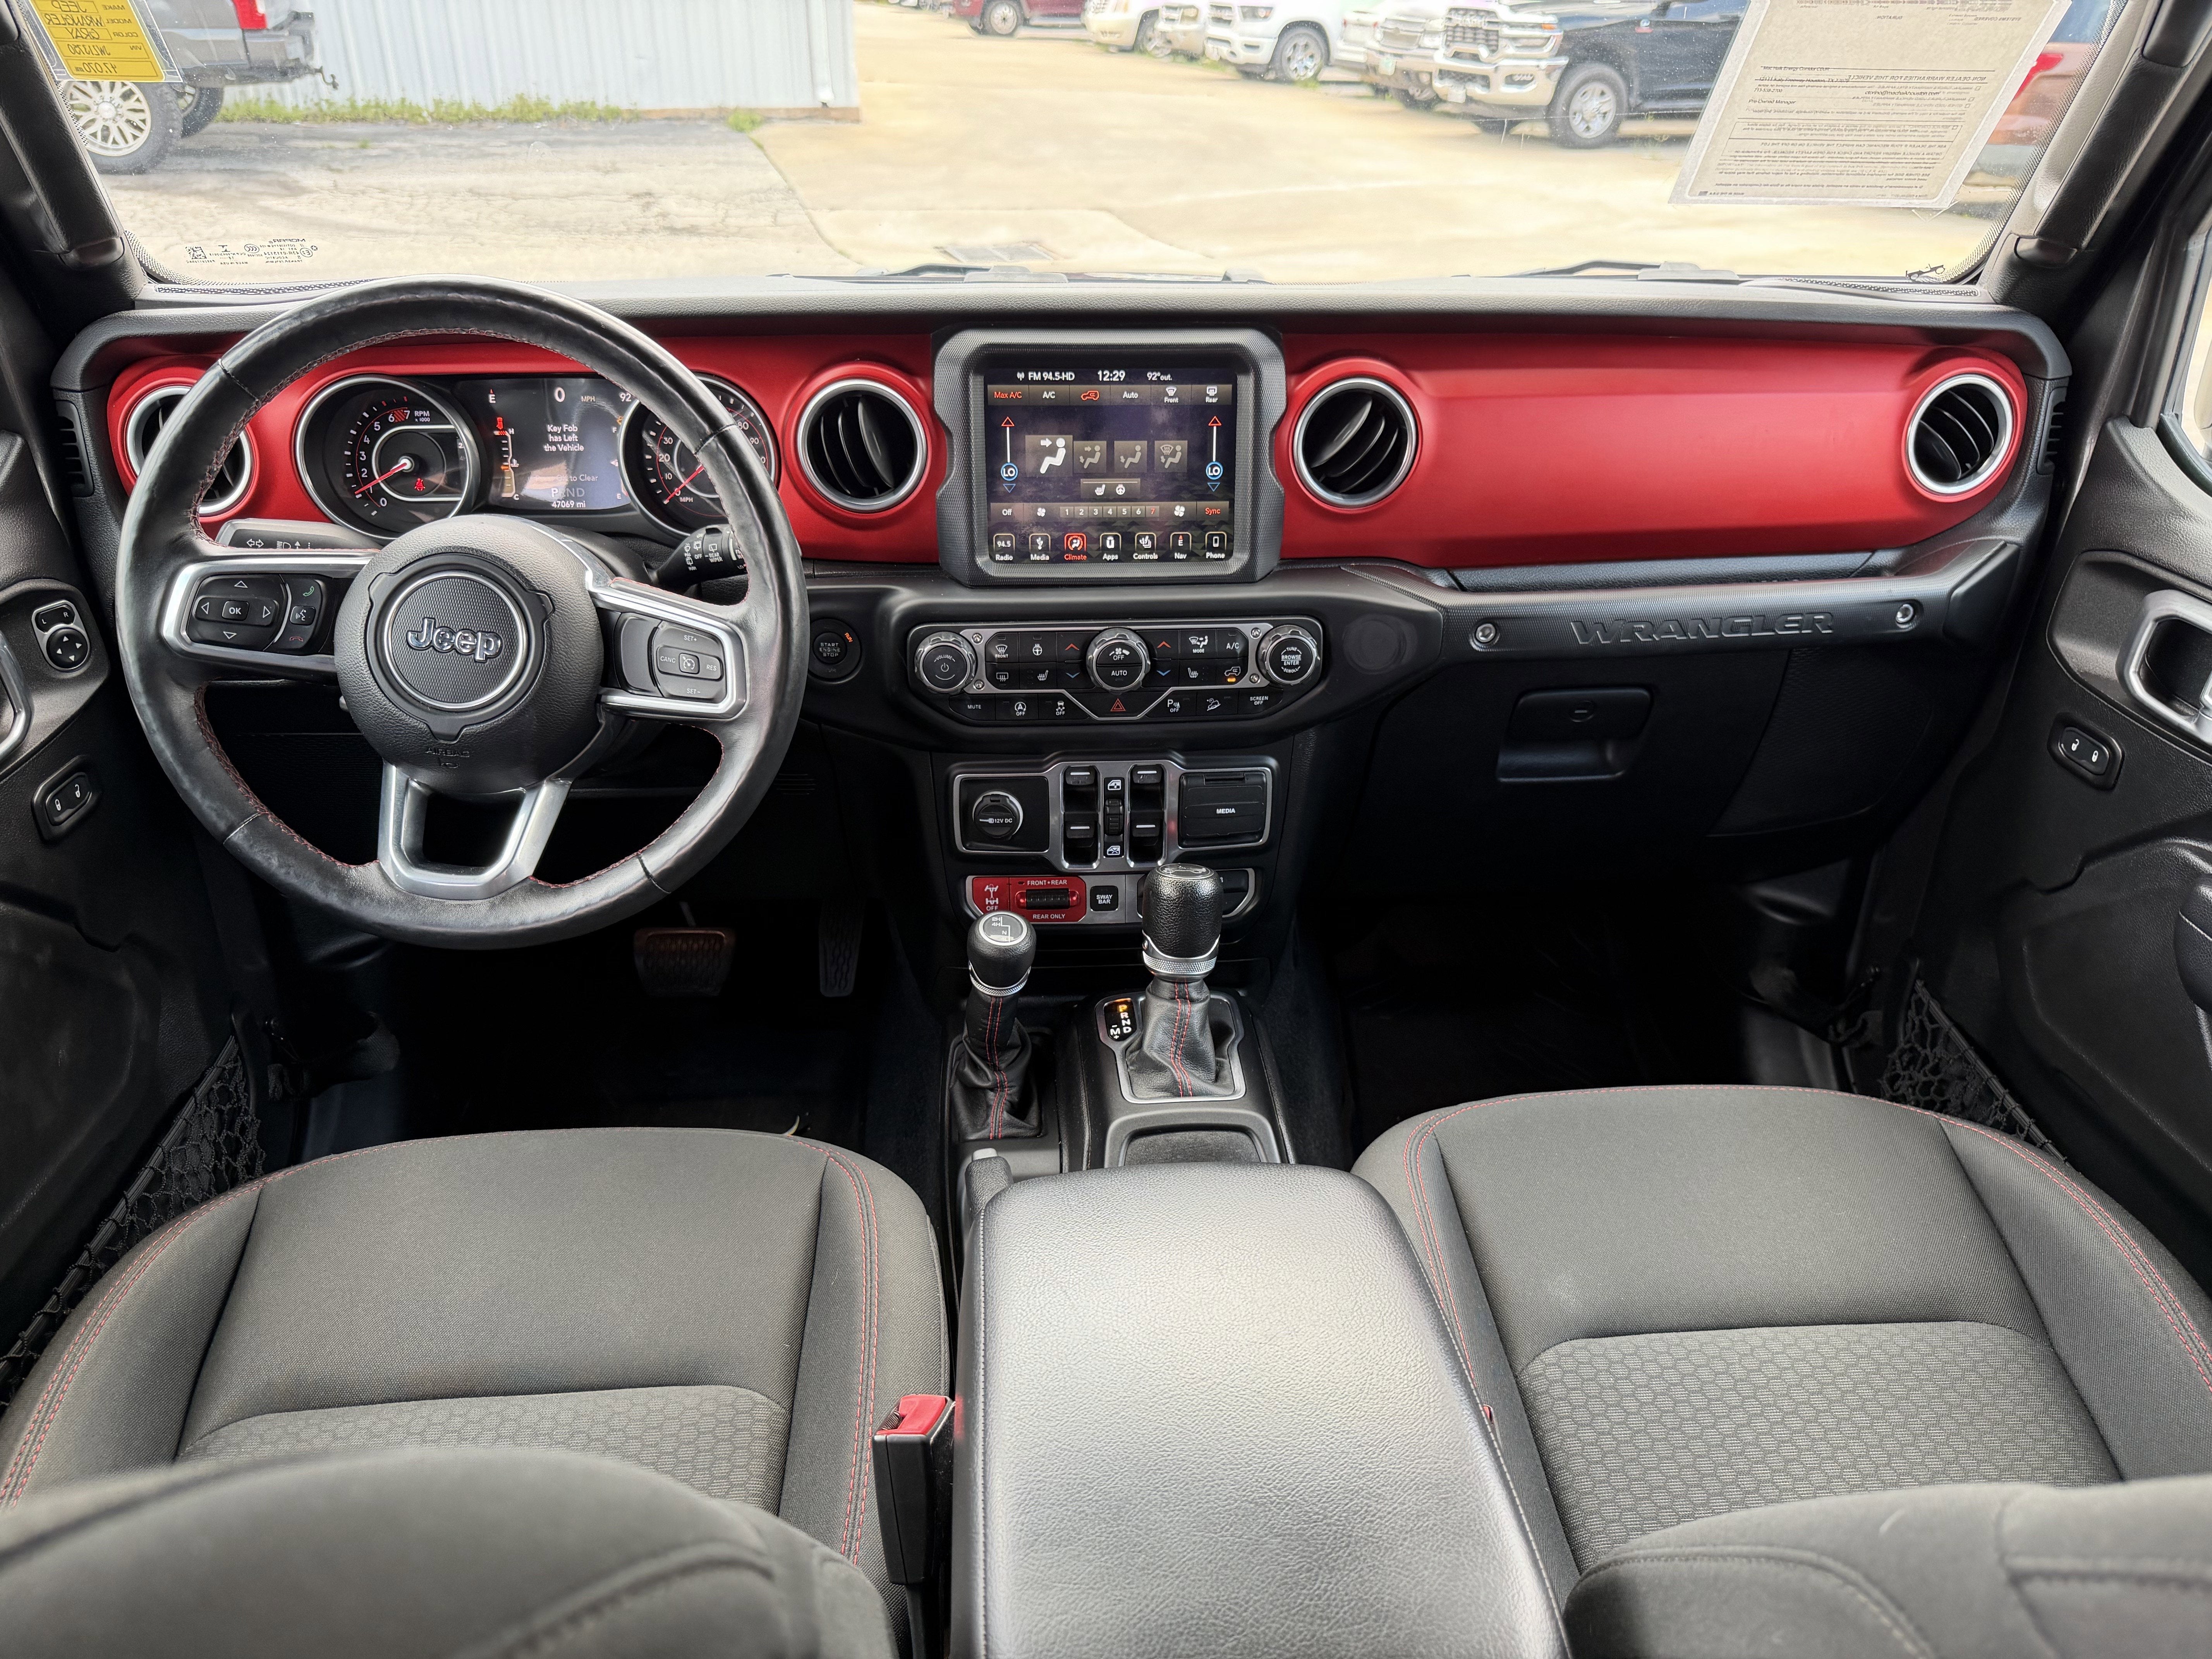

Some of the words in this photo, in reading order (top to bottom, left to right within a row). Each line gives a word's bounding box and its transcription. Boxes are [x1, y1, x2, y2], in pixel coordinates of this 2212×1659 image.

[1029, 372, 1041, 381] FM
[1042, 372, 1075, 381] 94.5-HD
[1097, 371, 1126, 381] 12:29
[489, 394, 496, 404] E
[554, 387, 565, 402] 0
[1042, 391, 1055, 399] A/C
[388, 414, 395, 422] 6
[404, 410, 410, 420] 7
[374, 422, 381, 431] 5
[547, 424, 562, 433] Key
[563, 424, 578, 432] Fob
[738, 421, 749, 430] 80
[364, 435, 370, 444] 4
[557, 444, 584, 452] Vehicle
[359, 451, 366, 461] 3
[659, 454, 670, 462] 20
[361, 468, 368, 478] 2
[1003, 468, 1016, 476] LO
[1208, 467, 1221, 476] LO
[579, 474, 598, 482] Clear
[551, 488, 558, 498] P
[380, 498, 387, 507] 0
[1002, 508, 1012, 516] Off
[1205, 507, 1221, 516] Sync
[997, 540, 1011, 548] 94.5
[1064, 553, 1087, 561] Climate
[1103, 553, 1118, 562] Apps
[1206, 551, 1225, 559] Phone
[229, 607, 242, 615] OK
[1570, 611, 1834, 645] WRANGLER
[406, 617, 503, 663] Jeep
[845, 632, 853, 642] RUN
[1226, 642, 1239, 651] A/C
